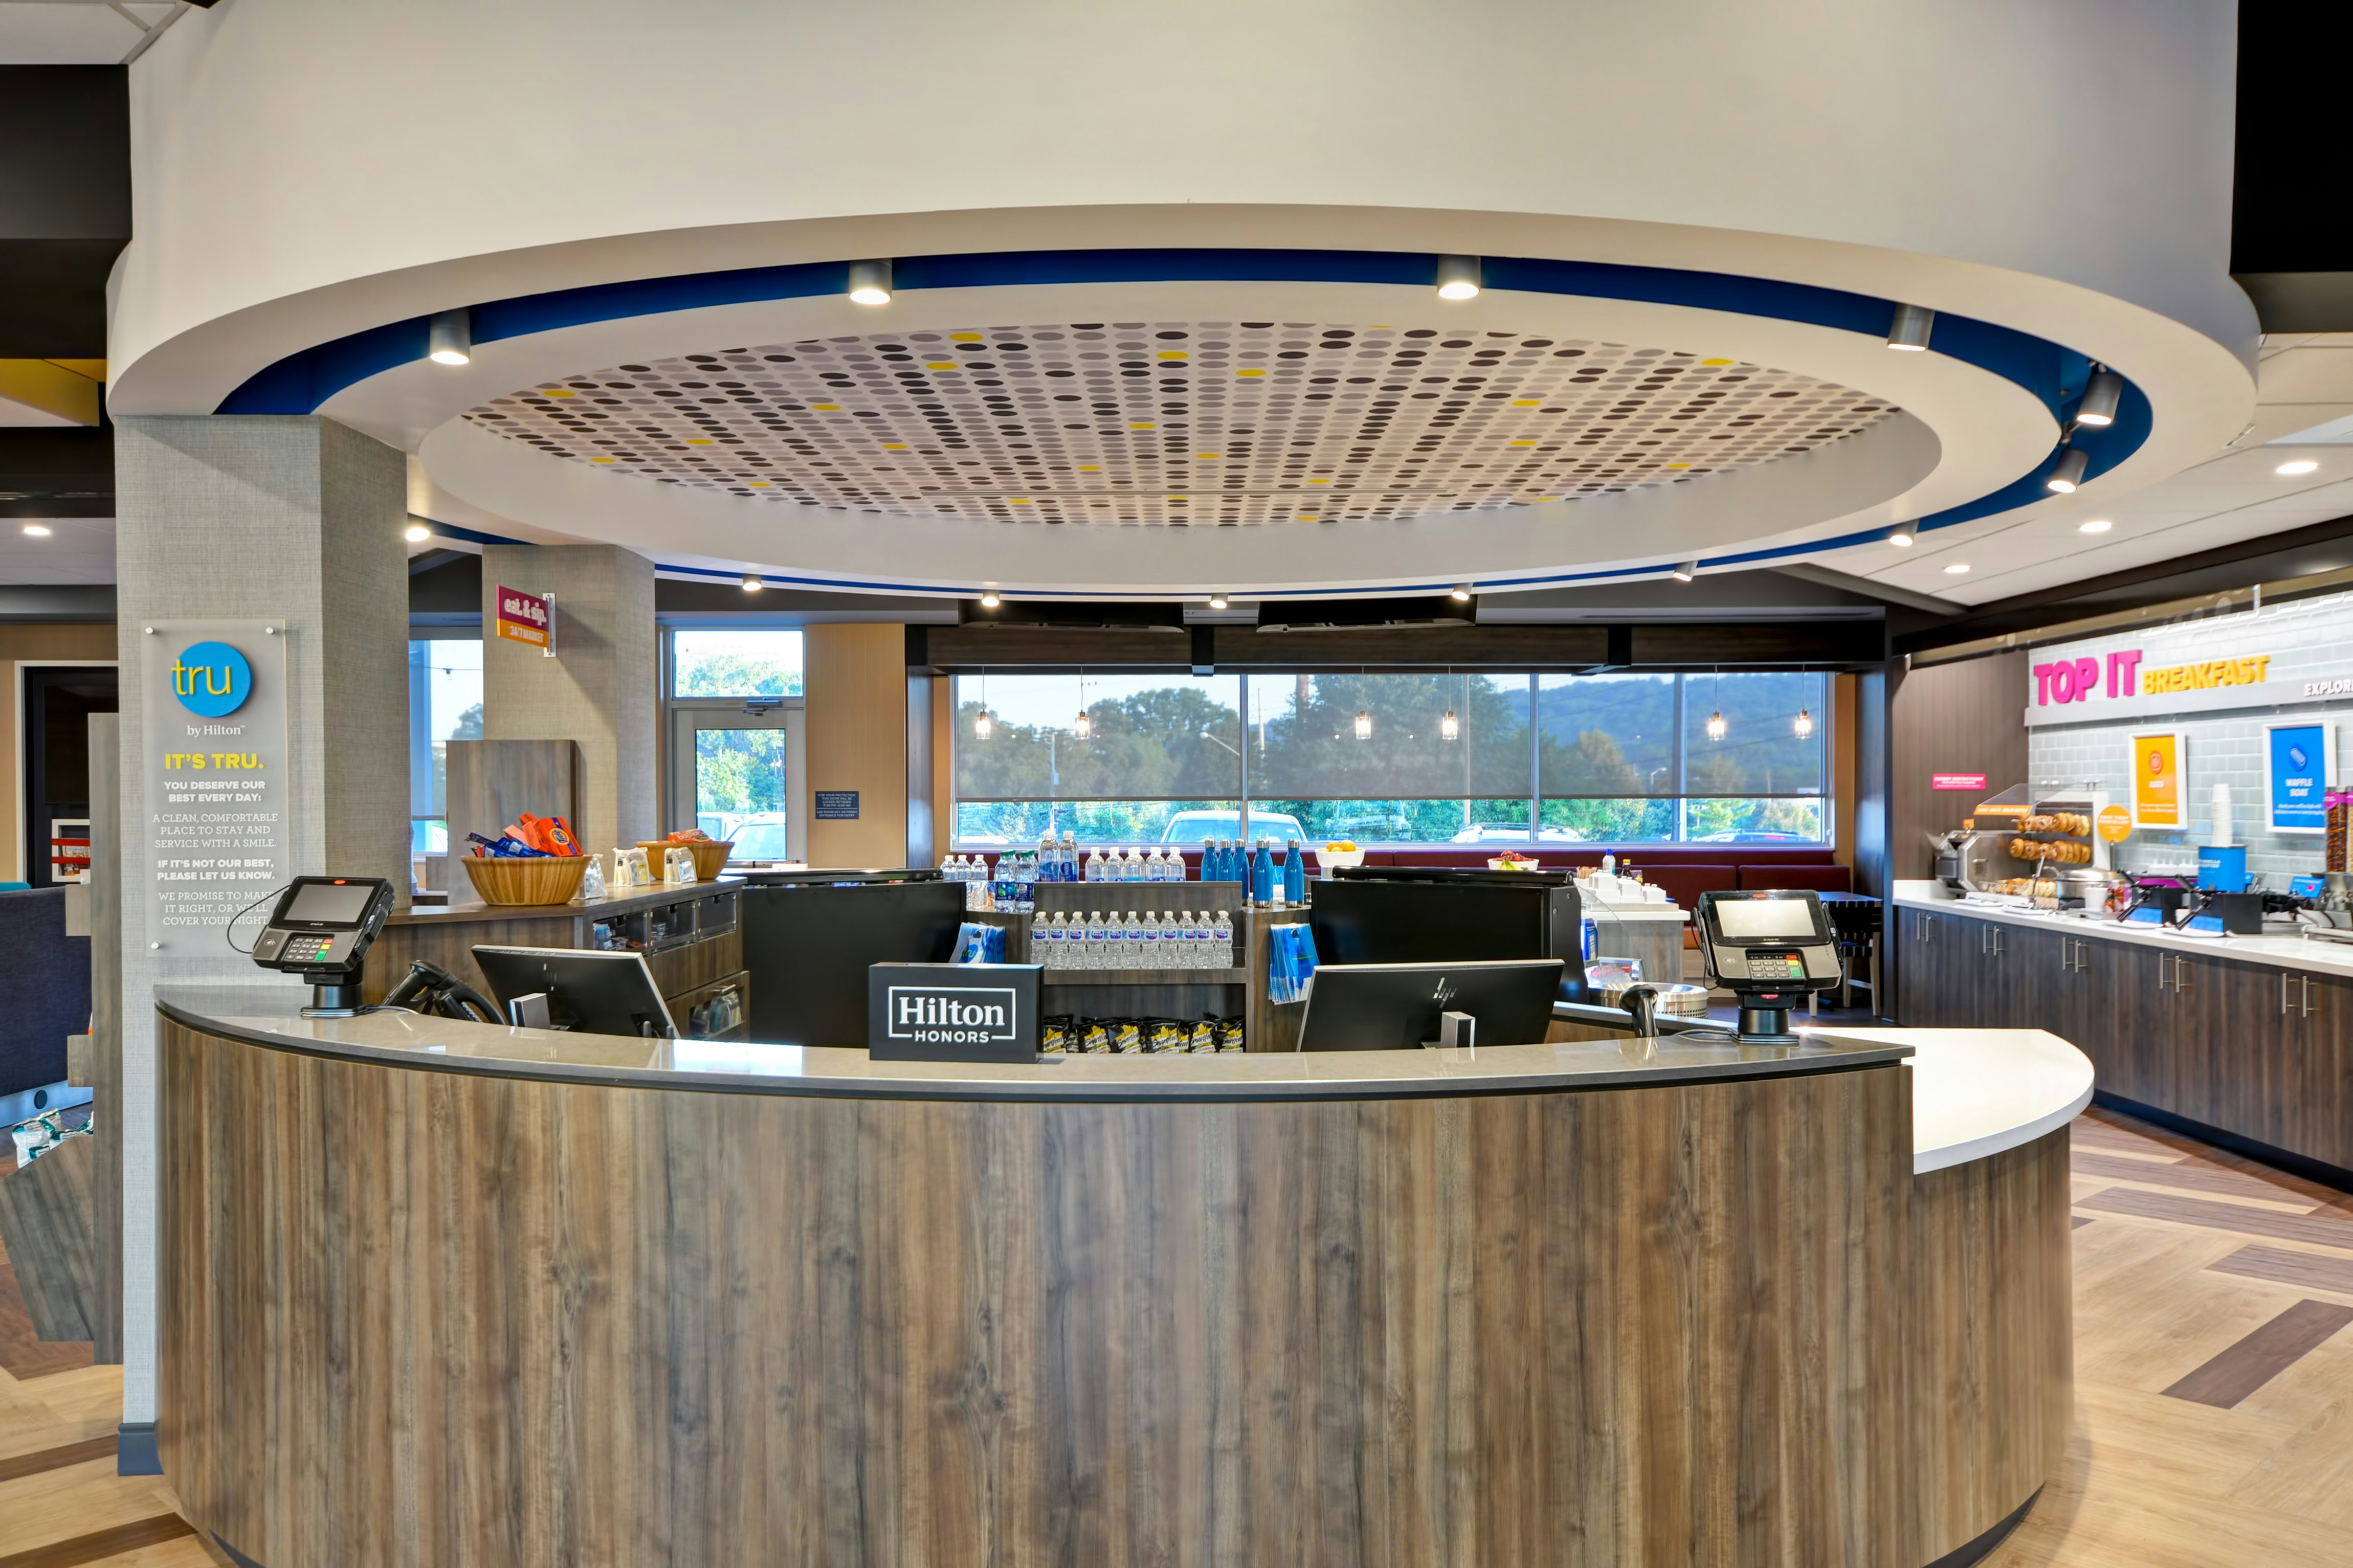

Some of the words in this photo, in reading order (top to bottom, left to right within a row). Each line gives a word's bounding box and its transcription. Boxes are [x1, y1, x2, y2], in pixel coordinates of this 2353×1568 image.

[523, 599, 531, 618] &
[171, 659, 232, 696] tru
[2033, 657, 2099, 706] TOP
[2107, 649, 2142, 698] IT
[2143, 655, 2271, 695] BREAKFAST
[2304, 678, 2353, 697] EXPLOR
[187, 725, 201, 737] by
[165, 753, 206, 769] IT'S
[212, 753, 264, 769] TRU.
[169, 794, 195, 802] BEST
[198, 794, 233, 802] EVERY
[236, 793, 261, 801] DAY:
[152, 814, 160, 822] A
[162, 814, 199, 823] CLEAN,
[201, 813, 278, 822] COMFORTABLE
[161, 826, 195, 835] PLACE
[216, 826, 243, 834] STAY
[246, 826, 270, 834] AND
[201, 839, 230, 847] WITH
[243, 839, 276, 847] SMILE.
[217, 859, 241, 867] OUR
[244, 859, 274, 868] BEST,
[158, 872, 197, 880] PLEASE
[178, 892, 224, 900] PROMISE
[244, 891, 275, 900] MAKE
[165, 905, 176, 913] IT
[179, 904, 215, 913] RIGHT,
[218, 904, 233, 912] OR
[236, 904, 268, 912] WELL
[163, 917, 199, 925] COVER
[202, 916, 231, 925] YOUR
[899, 997, 1005, 1026] Hilton
[915, 1029, 989, 1043] HONORS
